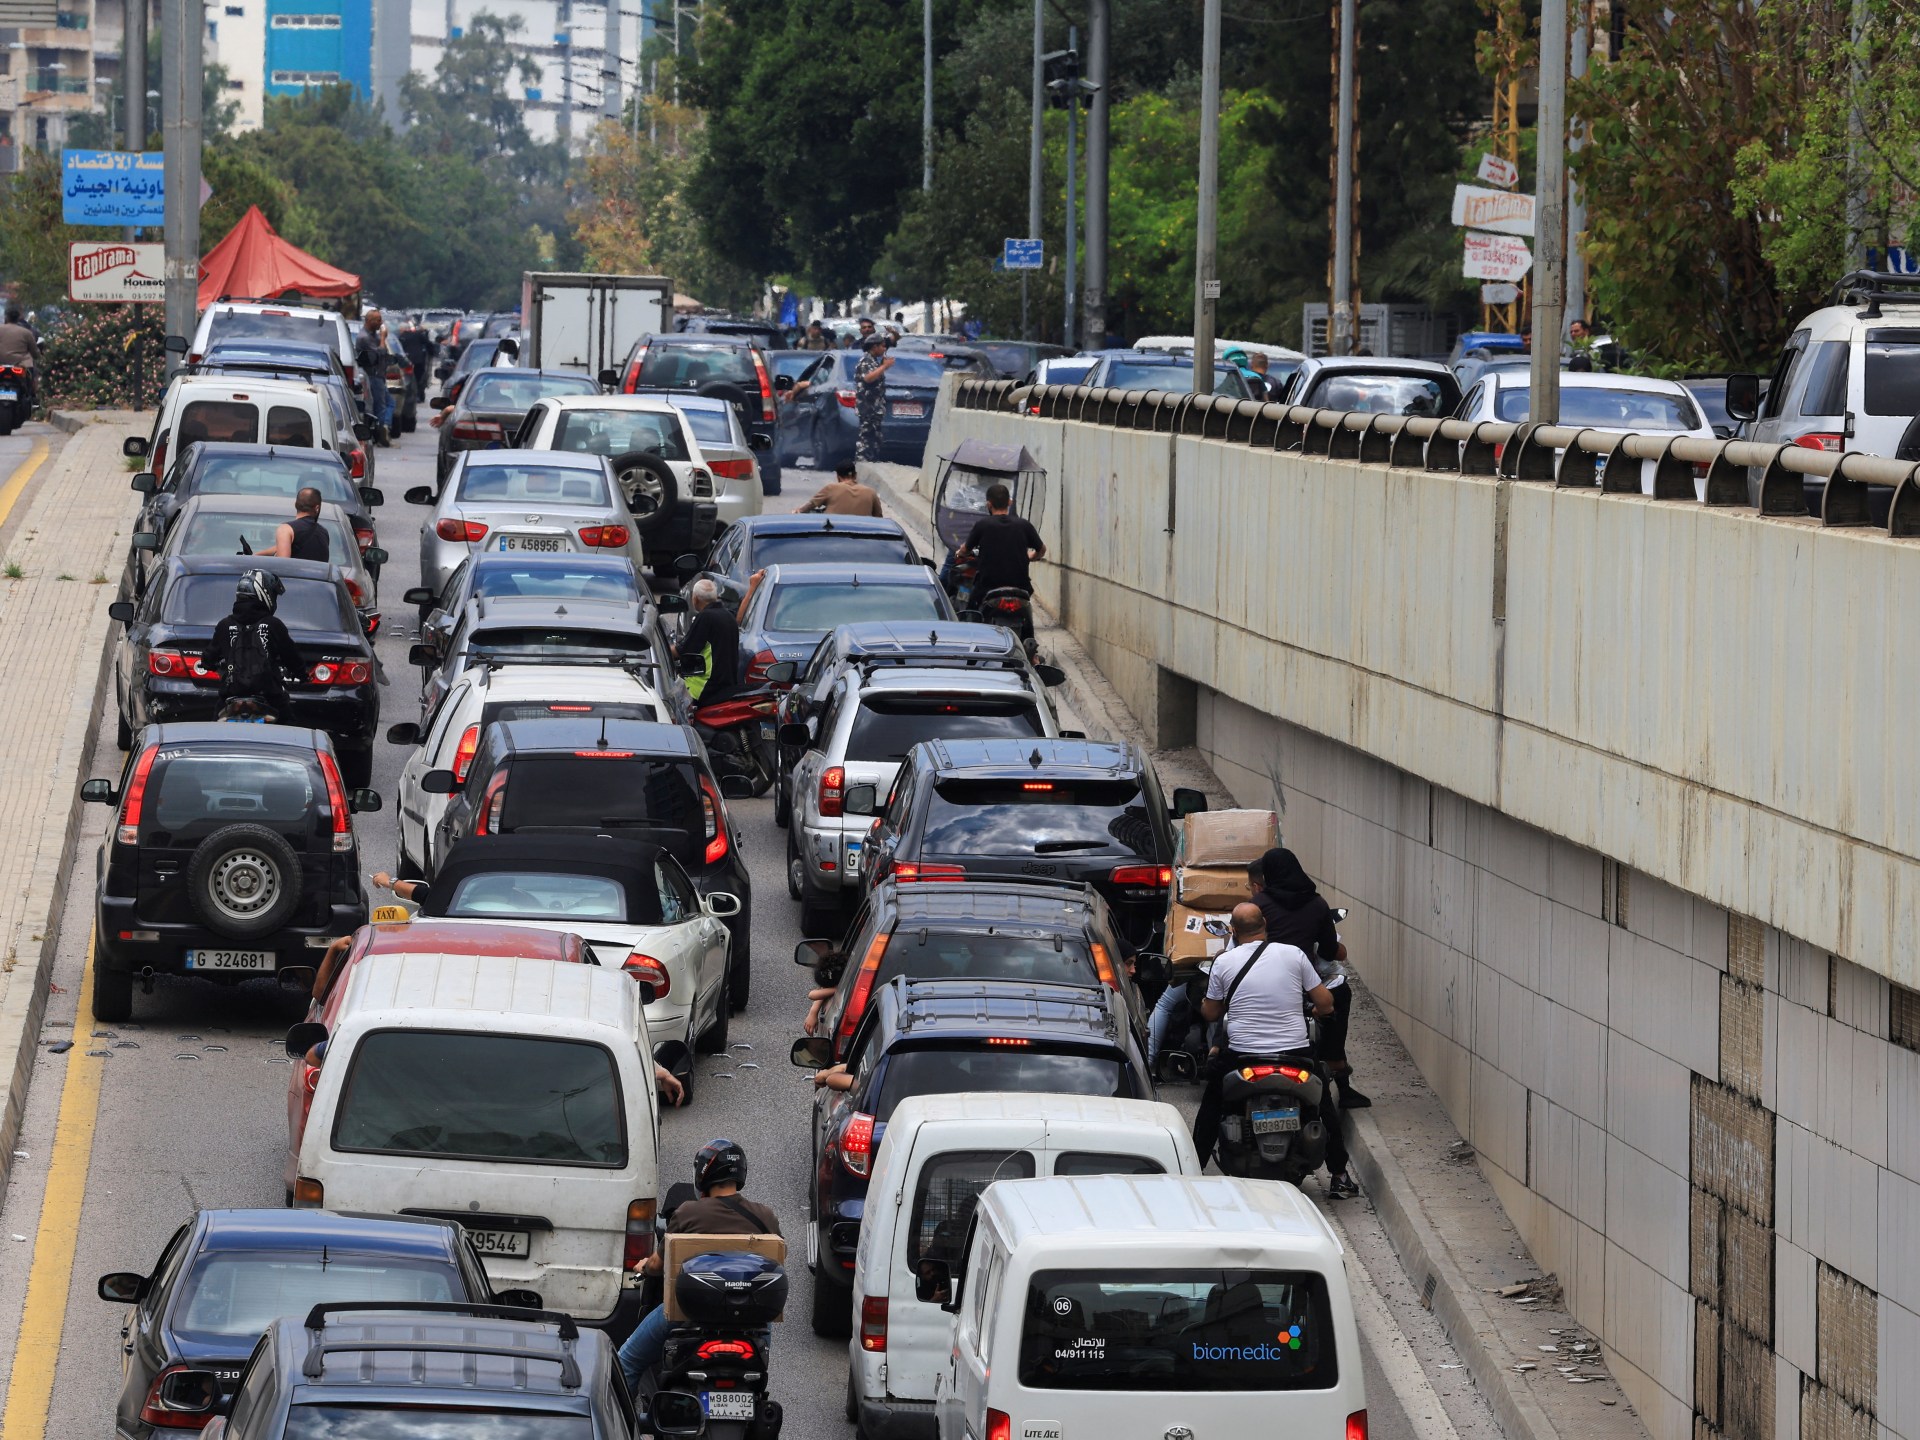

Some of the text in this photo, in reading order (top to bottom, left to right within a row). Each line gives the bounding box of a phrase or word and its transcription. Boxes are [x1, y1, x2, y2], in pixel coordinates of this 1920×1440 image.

[508, 538, 559, 552] G 458956
[1021, 861, 1056, 875] Jeep
[375, 910, 395, 920] TAXI
[197, 952, 265, 968] G 324681
[1255, 1118, 1298, 1132] M938769
[1056, 1301, 1069, 1311] 06
[1192, 1342, 1281, 1360] biomedic
